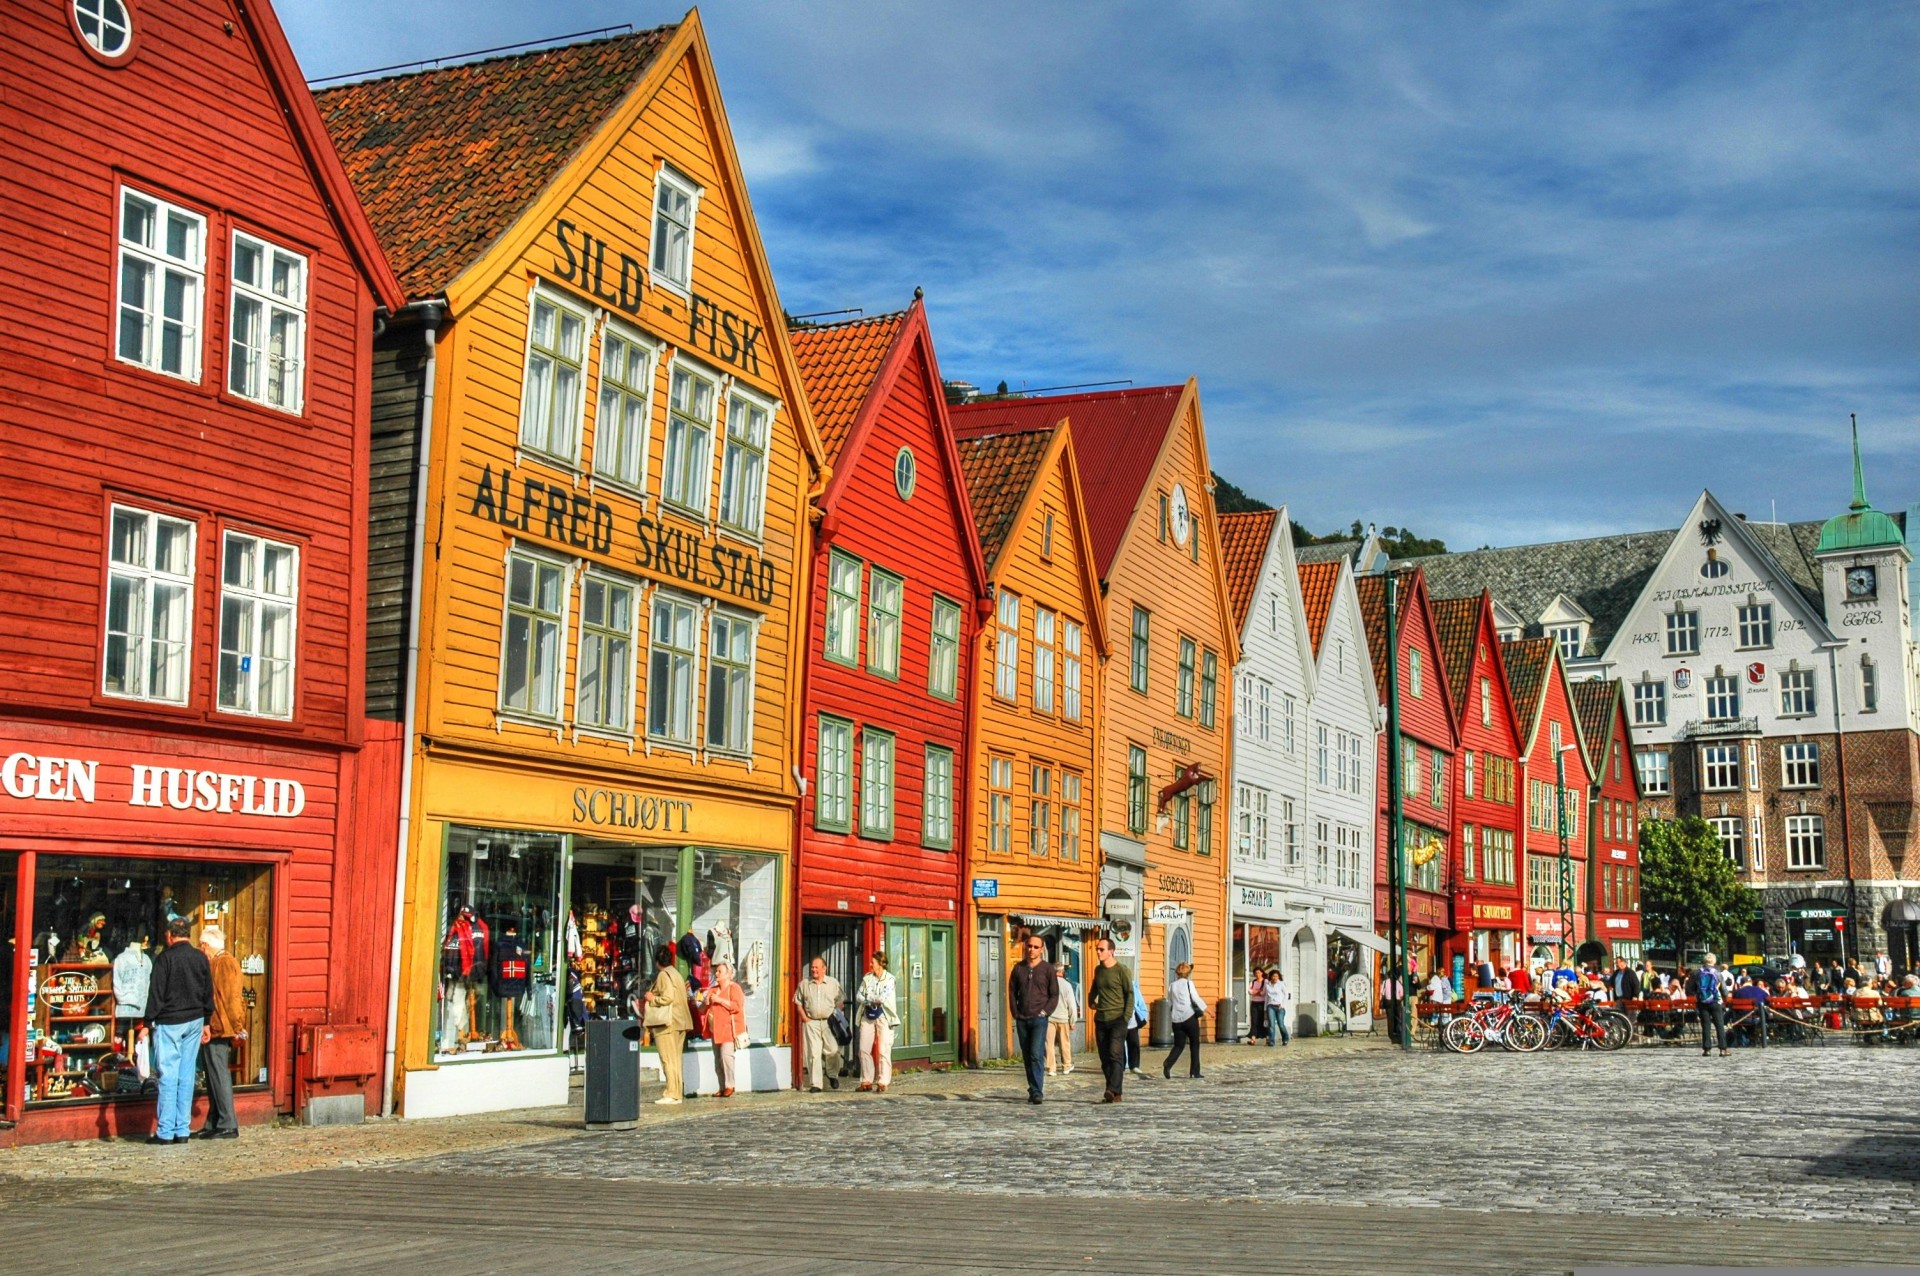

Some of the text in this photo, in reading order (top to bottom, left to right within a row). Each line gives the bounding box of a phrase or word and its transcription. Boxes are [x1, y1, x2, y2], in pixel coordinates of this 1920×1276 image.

[554, 219, 644, 315] SILD
[689, 294, 763, 377] FISK
[470, 463, 775, 605] ALFRED SKULSTAD
[0, 752, 306, 817] GEN HUSFLID
[573, 786, 693, 833] SCHJØTT
[1808, 910, 1832, 918] NOTAR
